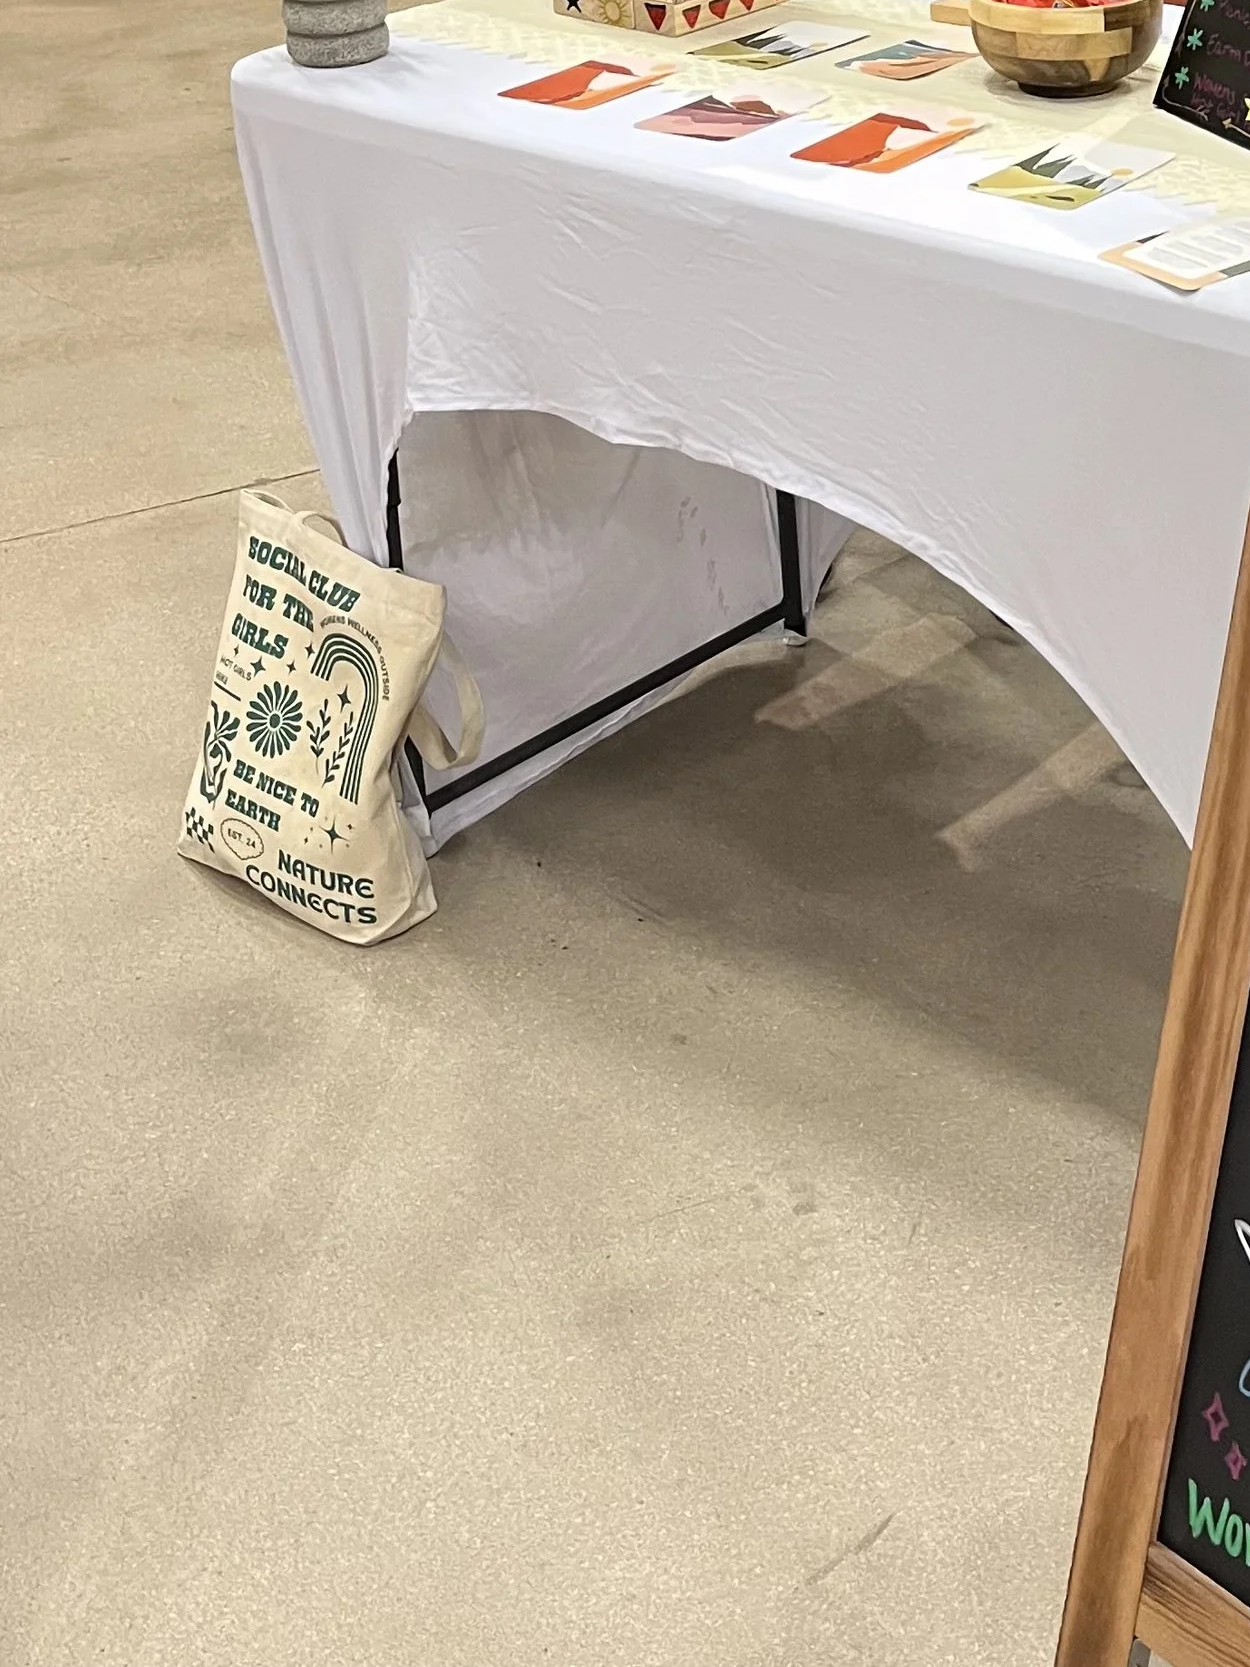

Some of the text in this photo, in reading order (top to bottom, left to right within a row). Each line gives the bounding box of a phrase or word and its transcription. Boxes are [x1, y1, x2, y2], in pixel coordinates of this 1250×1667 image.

[243, 574, 314, 632] FOR THE
[249, 536, 361, 612] SOCIAL CLUB
[232, 613, 289, 659] GIRLS
[225, 788, 281, 832] EARTH
[233, 759, 320, 818] BE NICE TO
[246, 864, 377, 924] CONNECTS
[278, 849, 375, 899] NATURE
